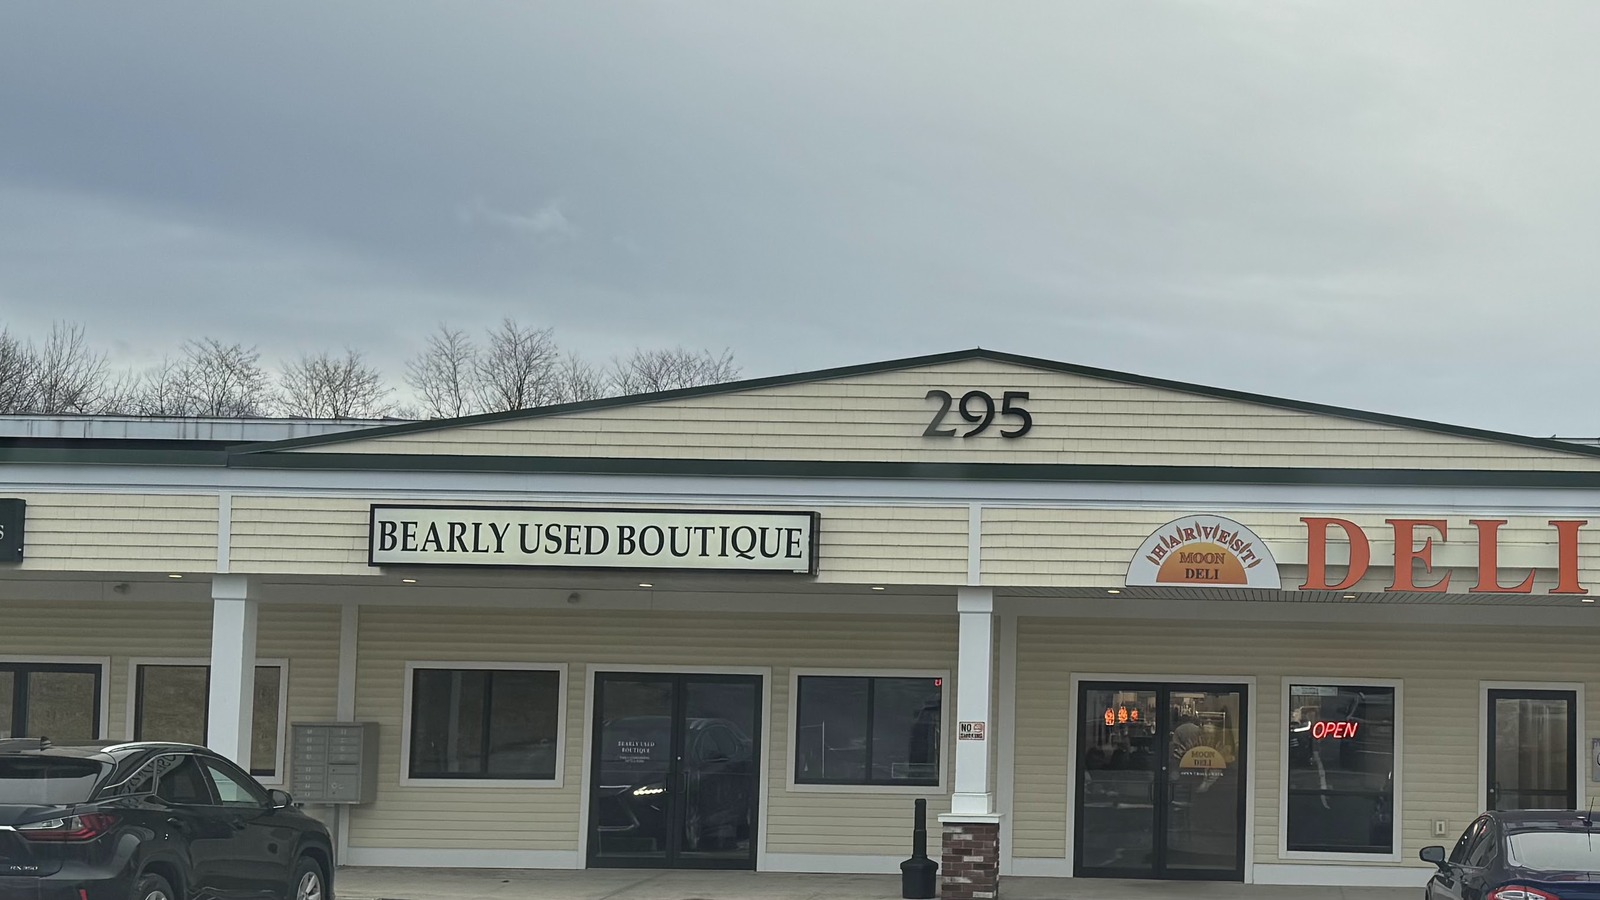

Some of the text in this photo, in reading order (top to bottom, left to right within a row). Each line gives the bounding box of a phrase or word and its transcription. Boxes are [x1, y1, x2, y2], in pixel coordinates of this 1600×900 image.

[922, 389, 1033, 439] 295
[378, 520, 803, 560] BEARLY USED BOUTIQUE
[1151, 526, 1257, 563] HARVEST
[1179, 552, 1226, 565] MOON
[1299, 517, 1588, 594] DELI
[1185, 568, 1220, 580] DELI
[961, 723, 972, 732] NO
[1312, 721, 1358, 739] OPEN
